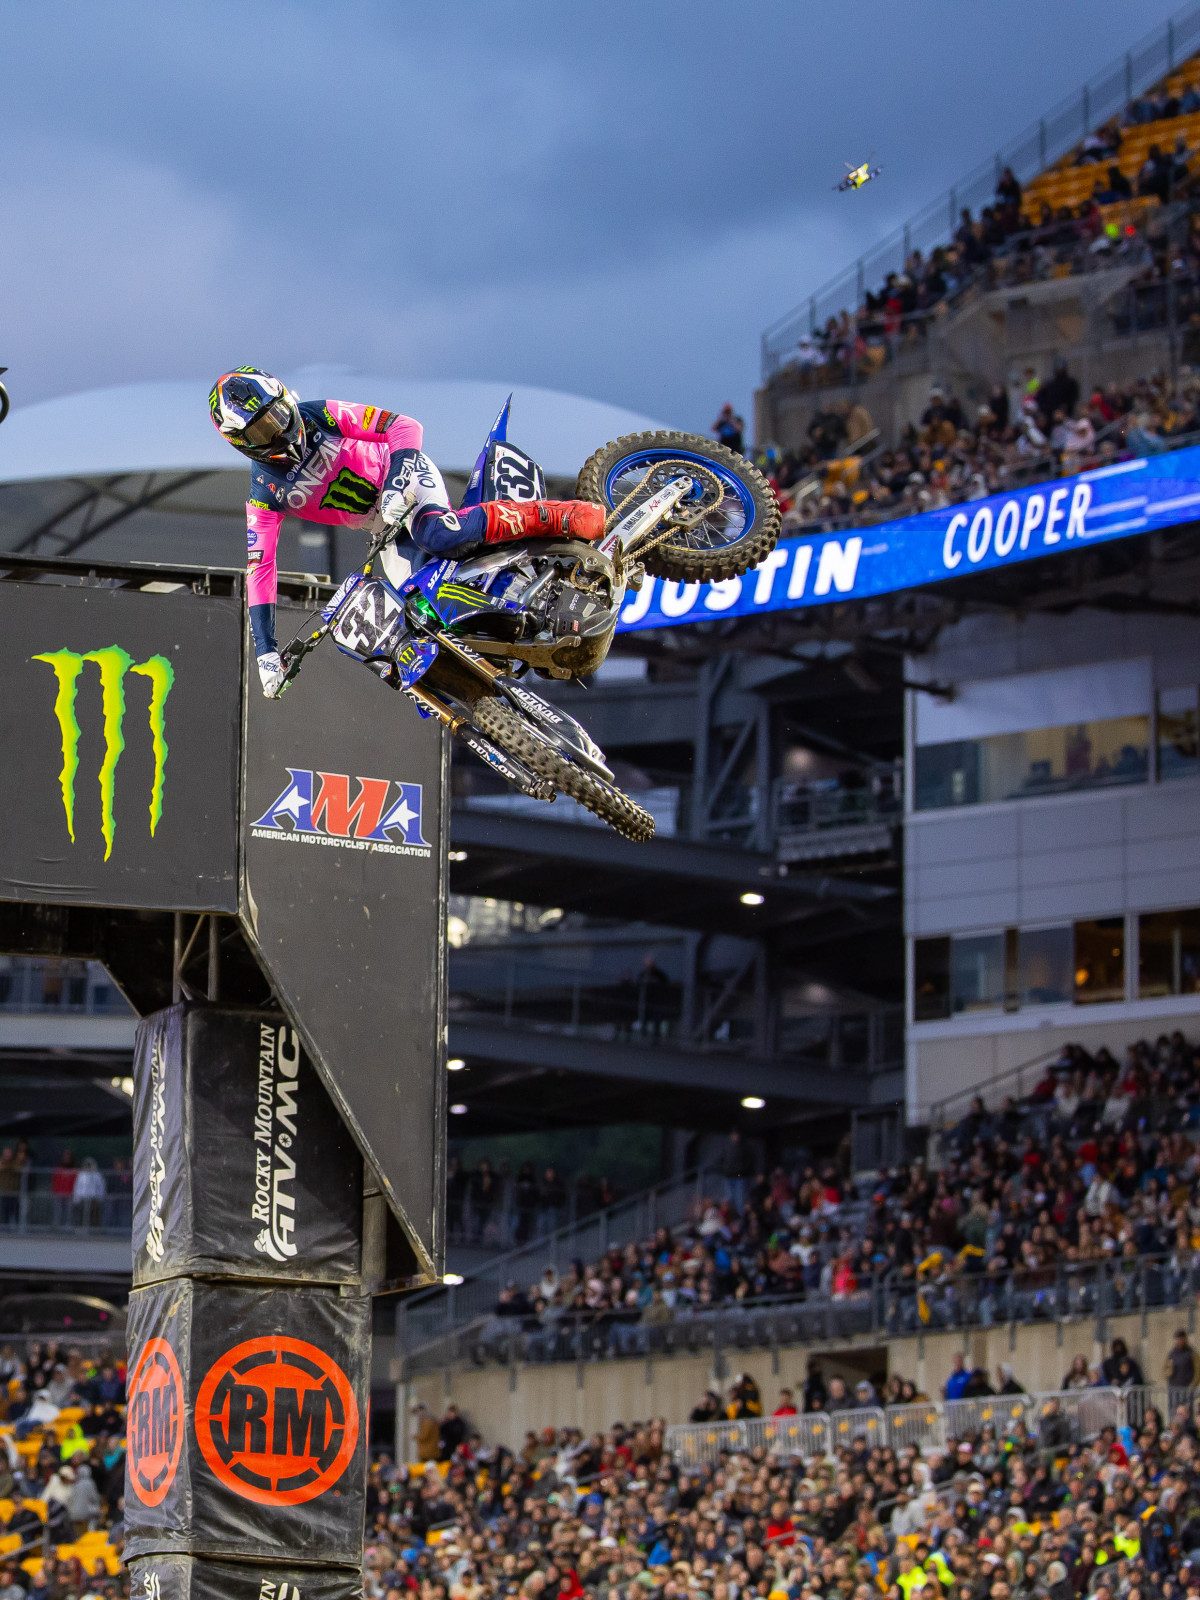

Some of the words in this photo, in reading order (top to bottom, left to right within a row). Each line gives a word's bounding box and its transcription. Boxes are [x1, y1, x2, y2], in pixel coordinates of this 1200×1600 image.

[942, 483, 1092, 570] COOPER
[510, 686, 563, 723] DUNLOP
[249, 767, 433, 848] AMA
[251, 828, 299, 843] AMERICAN
[301, 834, 370, 851] MOTORCYCLIST
[371, 842, 431, 859] ASSOCIATION
[253, 1022, 276, 1148] MOUNTAIN
[251, 1147, 272, 1225] ROCKY
[228, 1384, 328, 1459] RM
